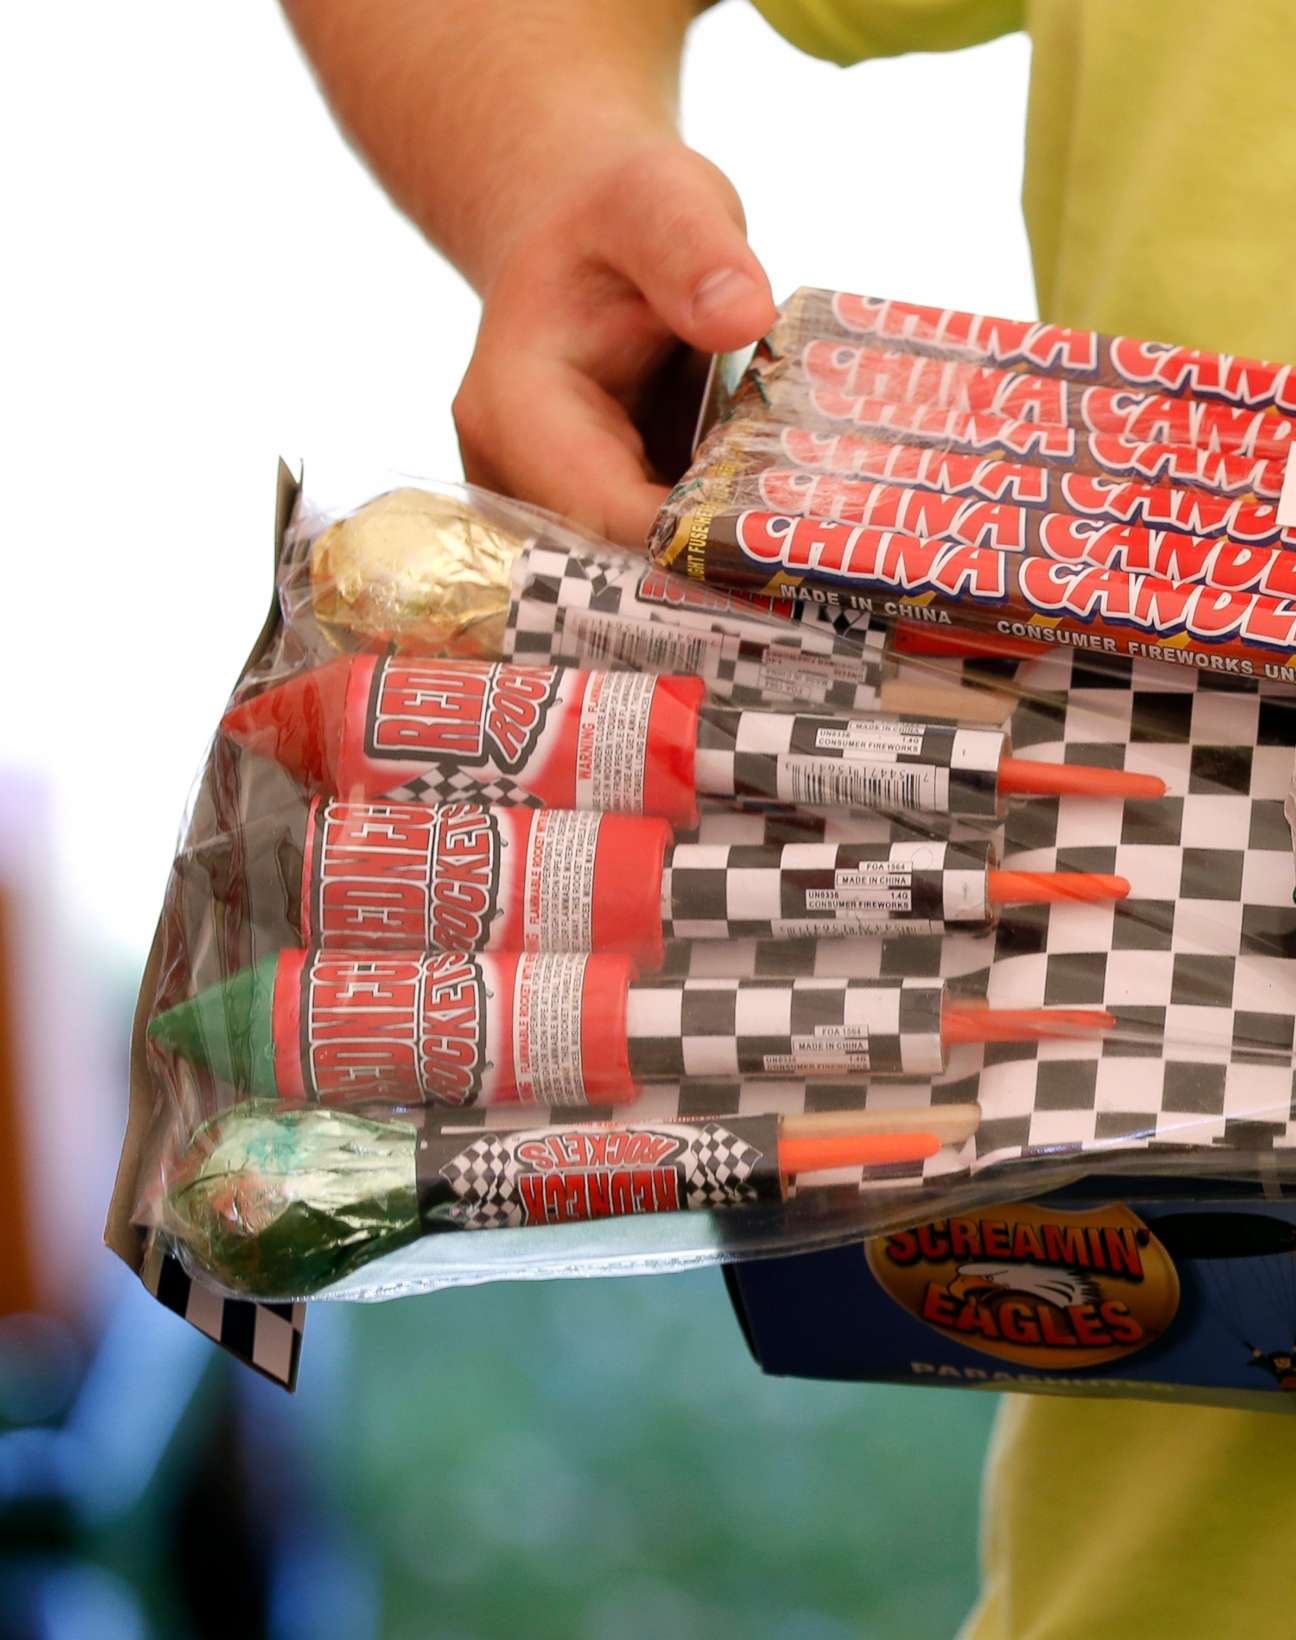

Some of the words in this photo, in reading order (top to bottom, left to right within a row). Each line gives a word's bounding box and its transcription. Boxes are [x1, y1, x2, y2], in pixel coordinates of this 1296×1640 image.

[833, 292, 1096, 370] CHINA
[803, 340, 1068, 425] CHINA
[781, 428, 1047, 502] CHINA
[808, 390, 1076, 457] CHINA
[1087, 430, 1288, 498] CAND
[758, 467, 1027, 551] CHINA
[735, 509, 1006, 598] CHINA
[780, 584, 840, 606] MADE
[851, 594, 873, 609] IN
[884, 602, 952, 625] CHINA
[997, 620, 1117, 653] CONSUMER
[1128, 640, 1254, 675] FIREWORKS
[578, 723, 594, 780] WARNING
[818, 738, 866, 749] CONSUMER
[867, 741, 919, 752] FIREWORKS
[808, 901, 857, 909] CONSUMER
[858, 901, 910, 910] FIREWORKS
[842, 874, 867, 884] MADE
[868, 875, 878, 884] IN
[879, 875, 907, 885] CHINA
[518, 1132, 679, 1170] ROCKETS
[518, 1165, 680, 1226] REDNECK
[922, 1284, 1144, 1346] EAGLES
